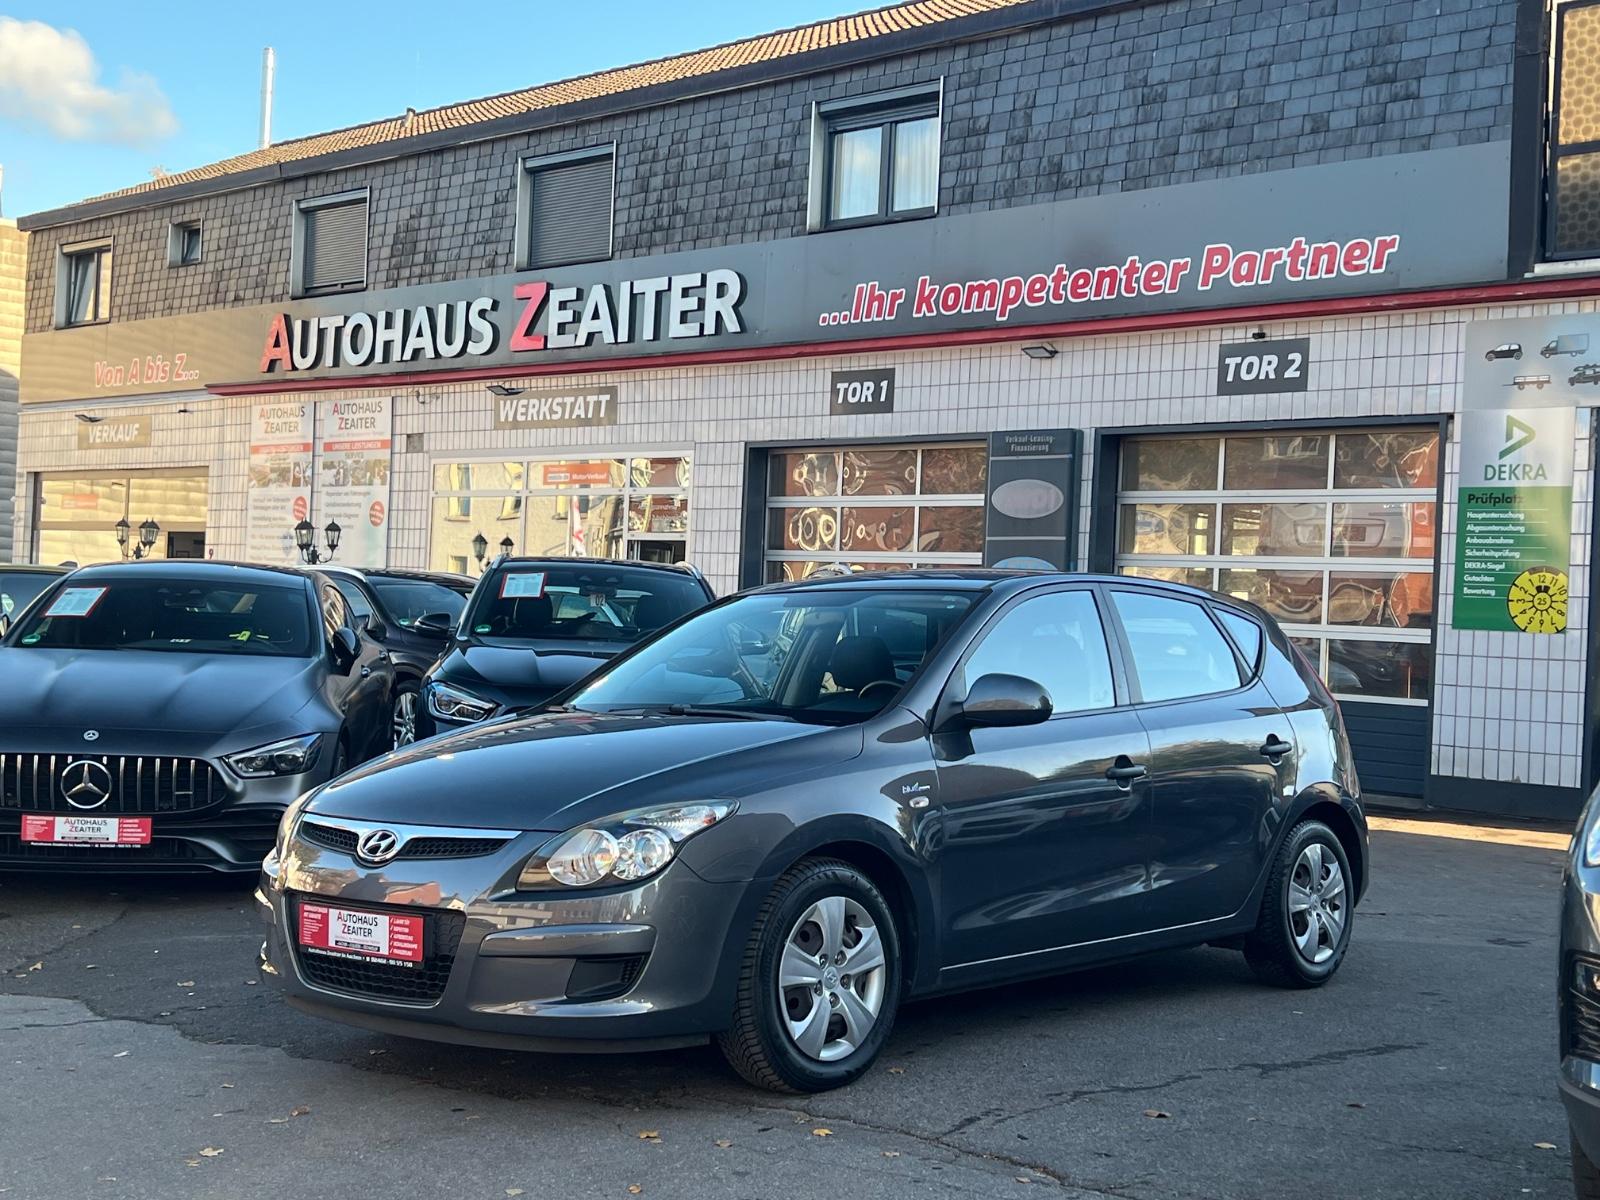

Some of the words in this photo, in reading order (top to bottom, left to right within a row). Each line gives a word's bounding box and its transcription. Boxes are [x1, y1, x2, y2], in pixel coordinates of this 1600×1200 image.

[819, 282, 904, 325] ...Ihr
[913, 256, 1190, 321] kompetenter
[1198, 235, 1399, 288] Partner
[260, 297, 497, 373] AUTOHAUS
[510, 269, 742, 352] ZEAITER
[94, 361, 124, 388] Von
[127, 359, 140, 384] A
[144, 355, 170, 384] bis
[173, 353, 200, 381] Z...
[1224, 354, 1279, 383] TOR
[1283, 352, 1302, 379] 2
[836, 381, 875, 404] TOR
[879, 379, 889, 403] 1
[259, 406, 305, 420] AUTOHAUS
[332, 401, 383, 415] AUTOHAUS
[499, 394, 611, 423] WERKSTATT
[264, 420, 299, 434] ZEAITER
[338, 417, 376, 431] ZEAITER
[88, 421, 141, 444] VERKAUF
[1484, 463, 1548, 481] DEKRA
[208, 548, 214, 560] 9
[1537, 574, 1546, 584] 12
[64, 817, 108, 826] AUTOHAUS
[337, 911, 378, 927] AUTOHAUS
[342, 924, 373, 938] ZEAITER
